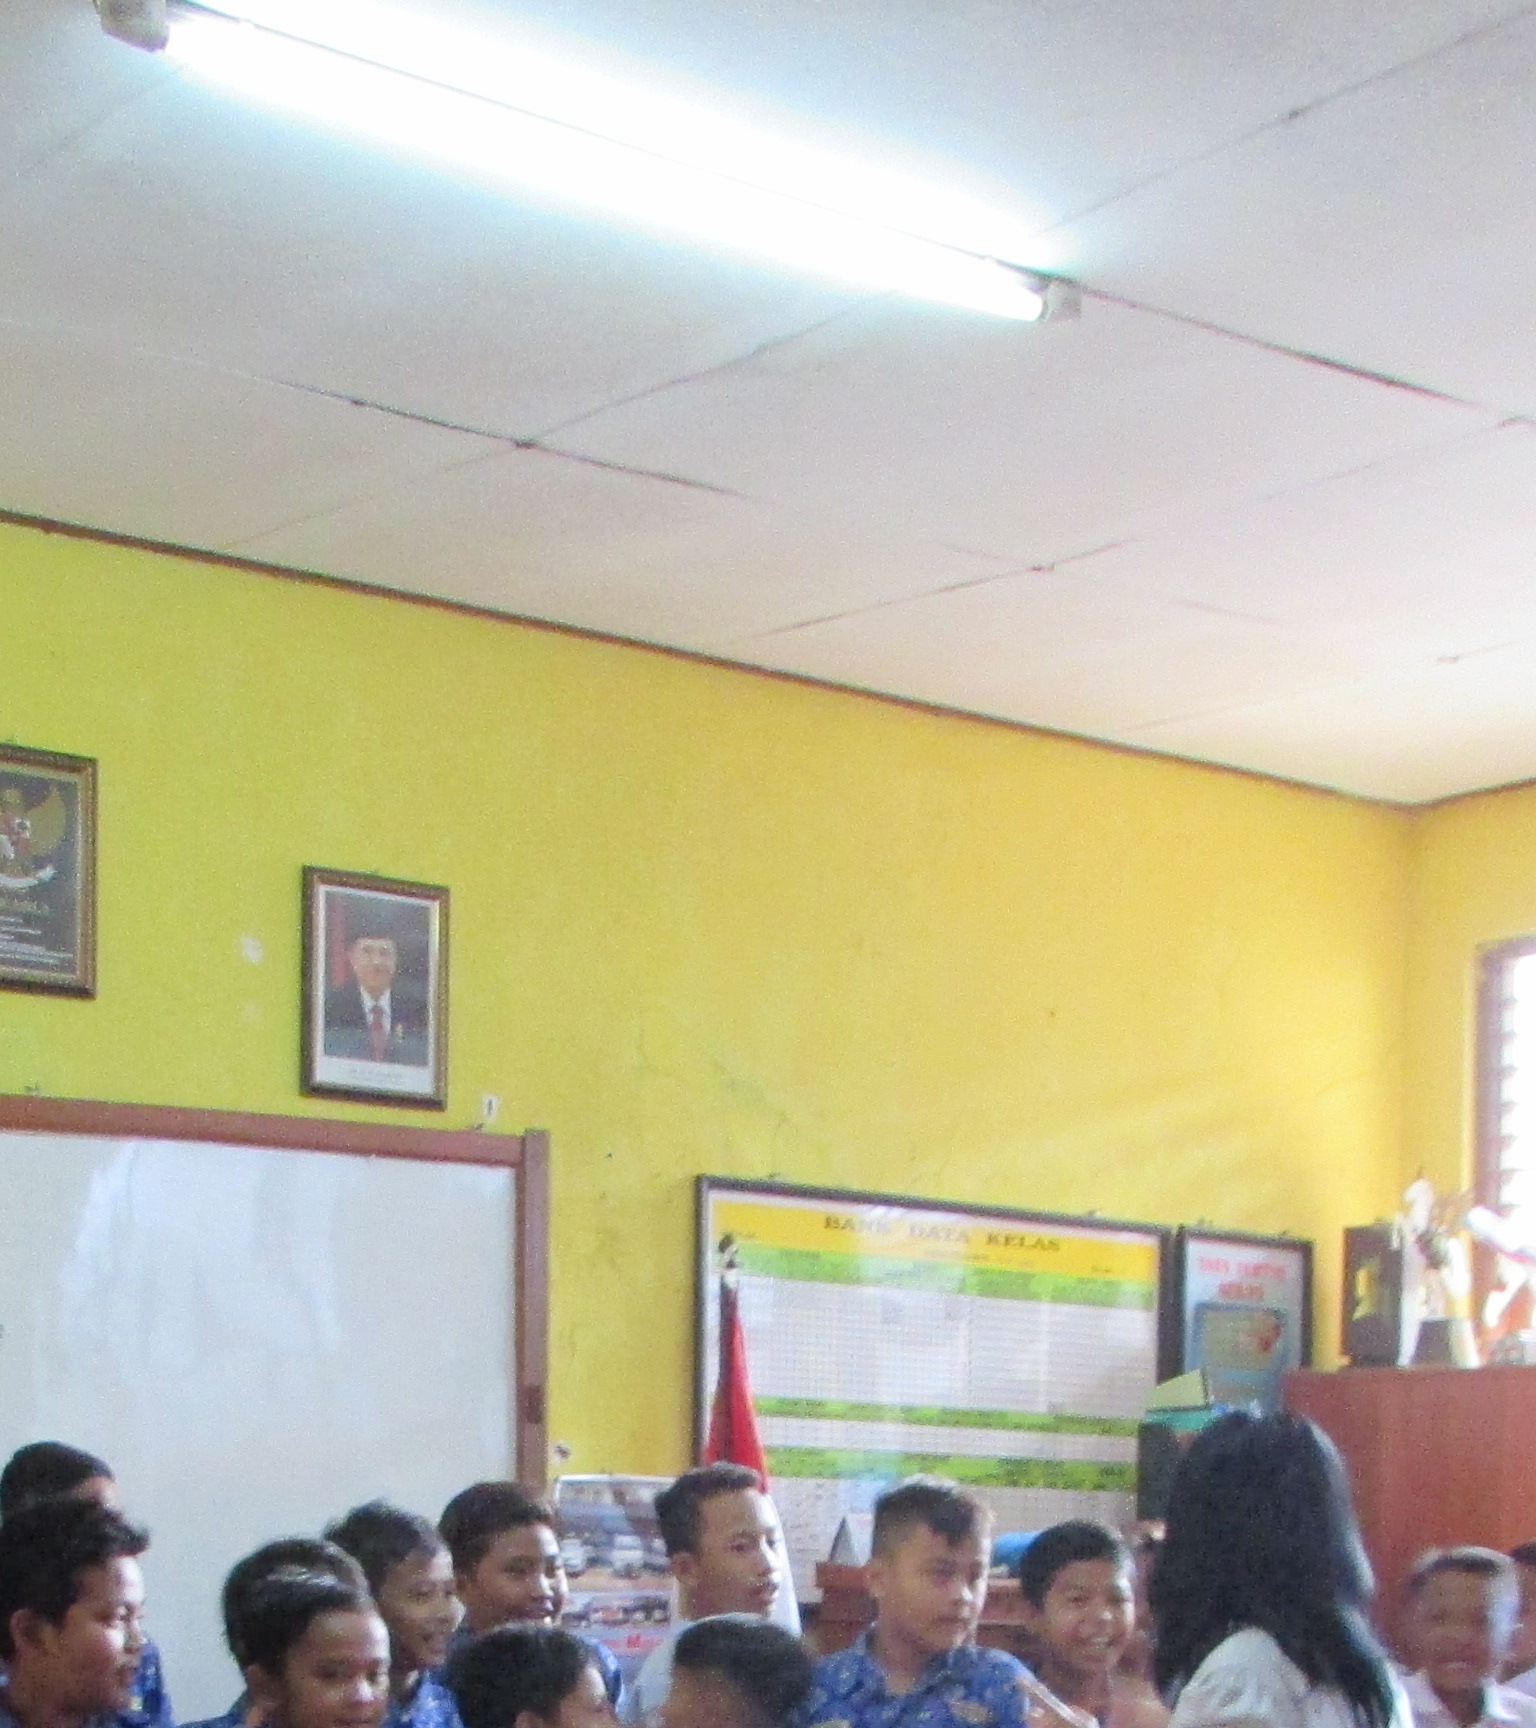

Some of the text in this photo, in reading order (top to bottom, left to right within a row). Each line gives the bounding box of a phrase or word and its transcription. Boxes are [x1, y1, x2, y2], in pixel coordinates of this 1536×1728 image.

[823, 1215, 1061, 1251] BANK DATA KELAS
